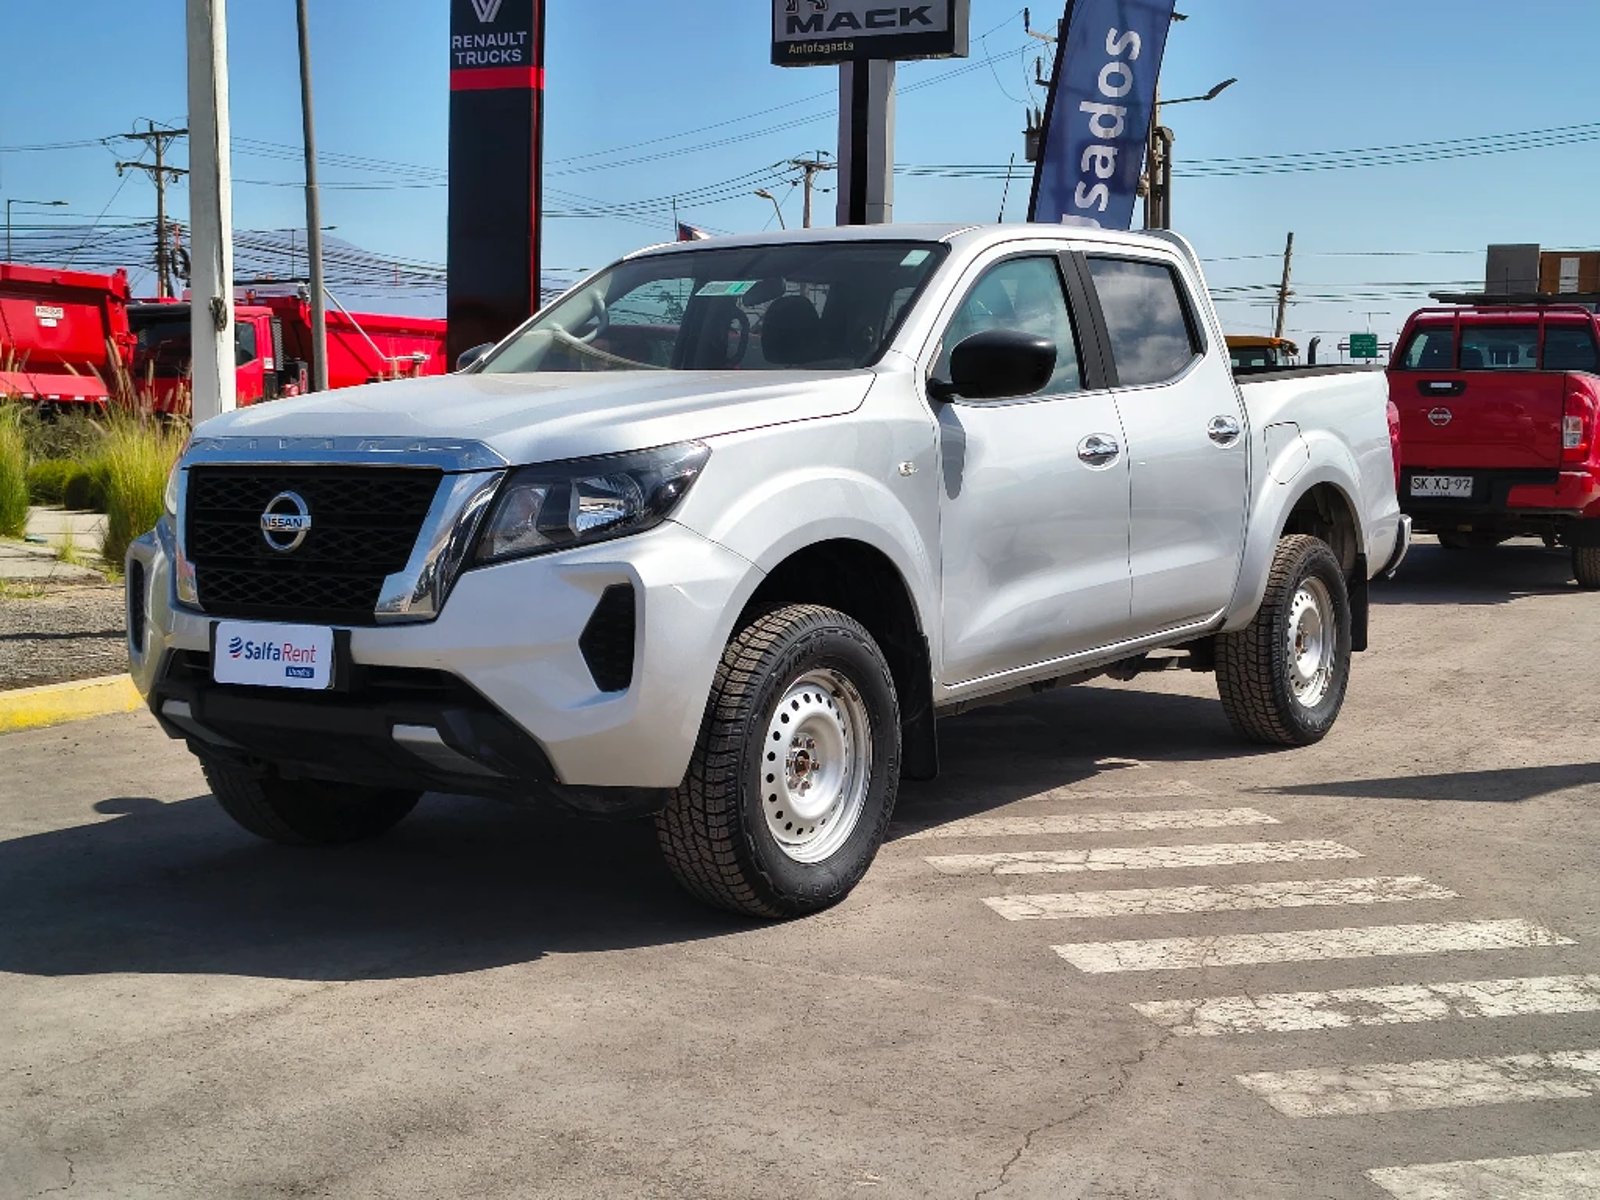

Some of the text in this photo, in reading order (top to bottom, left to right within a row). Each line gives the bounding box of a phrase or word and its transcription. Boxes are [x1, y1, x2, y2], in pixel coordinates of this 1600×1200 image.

[786, 6, 933, 35] MACK
[452, 31, 527, 48] RENAULT
[788, 41, 854, 54] Antofagasta
[455, 49, 522, 65] TRUCKS
[262, 517, 303, 528] NISSAN
[245, 641, 317, 663] SalfaRent
